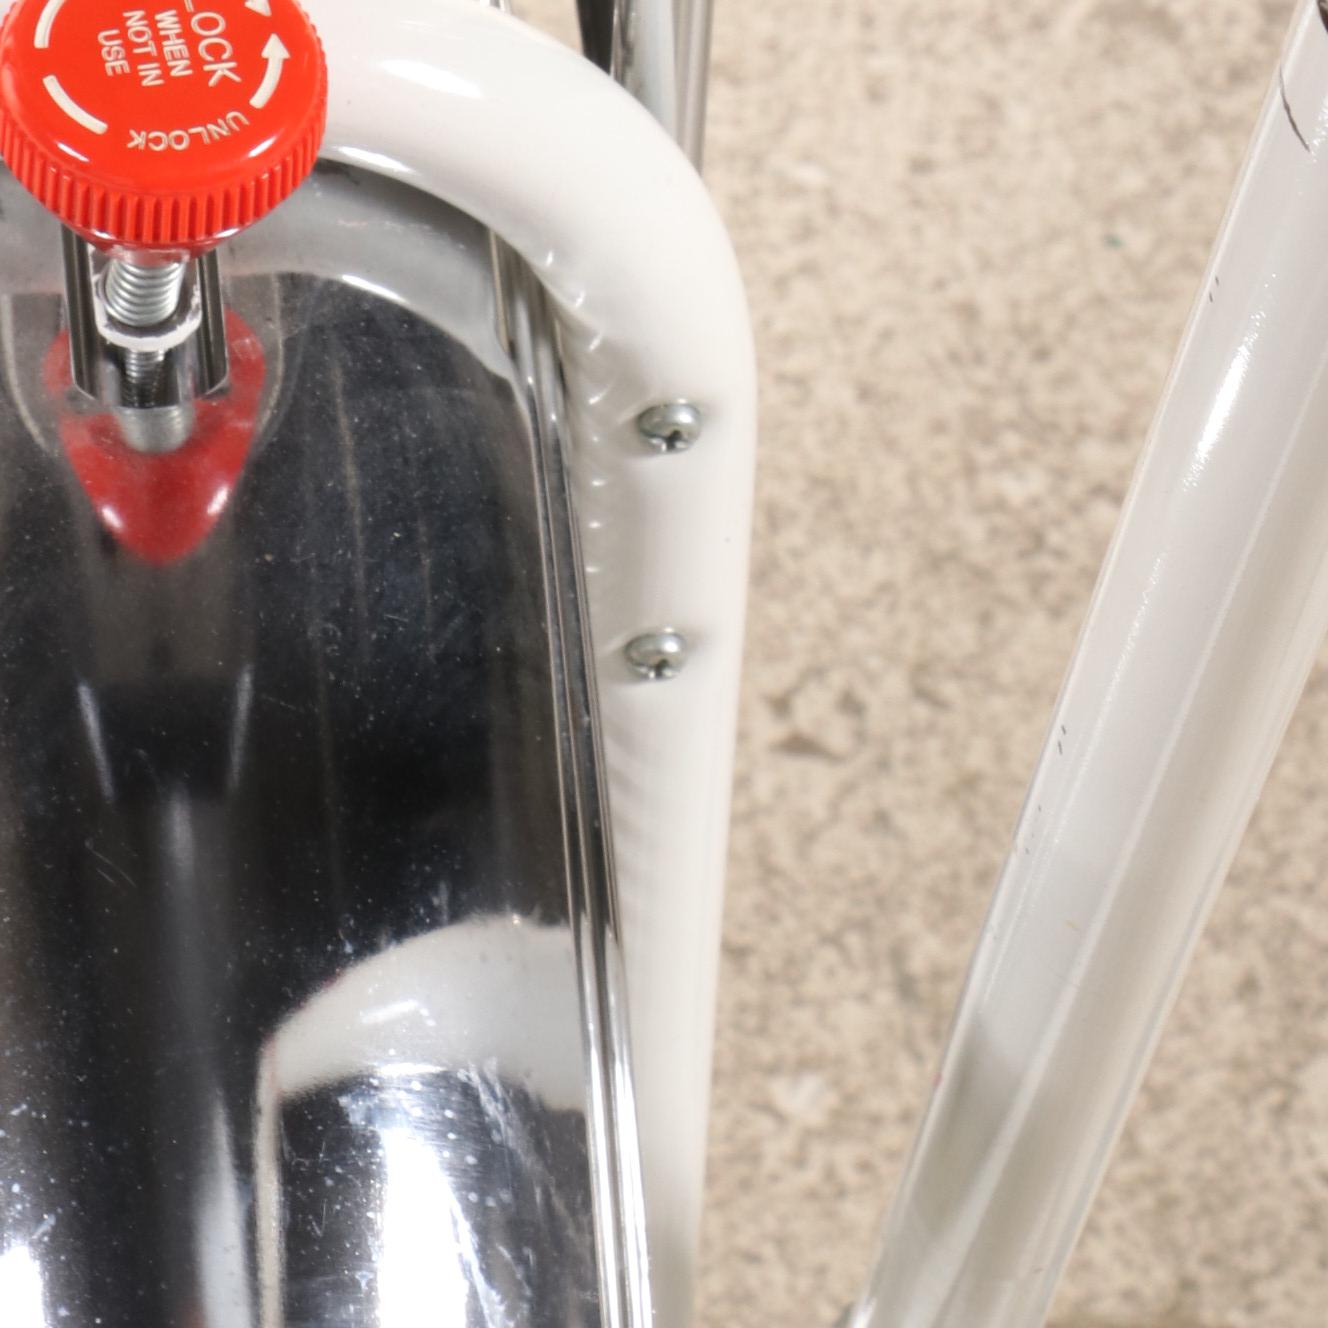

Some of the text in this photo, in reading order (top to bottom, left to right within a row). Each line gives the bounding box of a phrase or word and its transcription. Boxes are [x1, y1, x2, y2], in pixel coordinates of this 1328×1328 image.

[97, 28, 130, 77] USE
[123, 9, 165, 88] NOT IN
[154, 9, 193, 78] WHEN
[126, 111, 251, 152] UNLOCK
